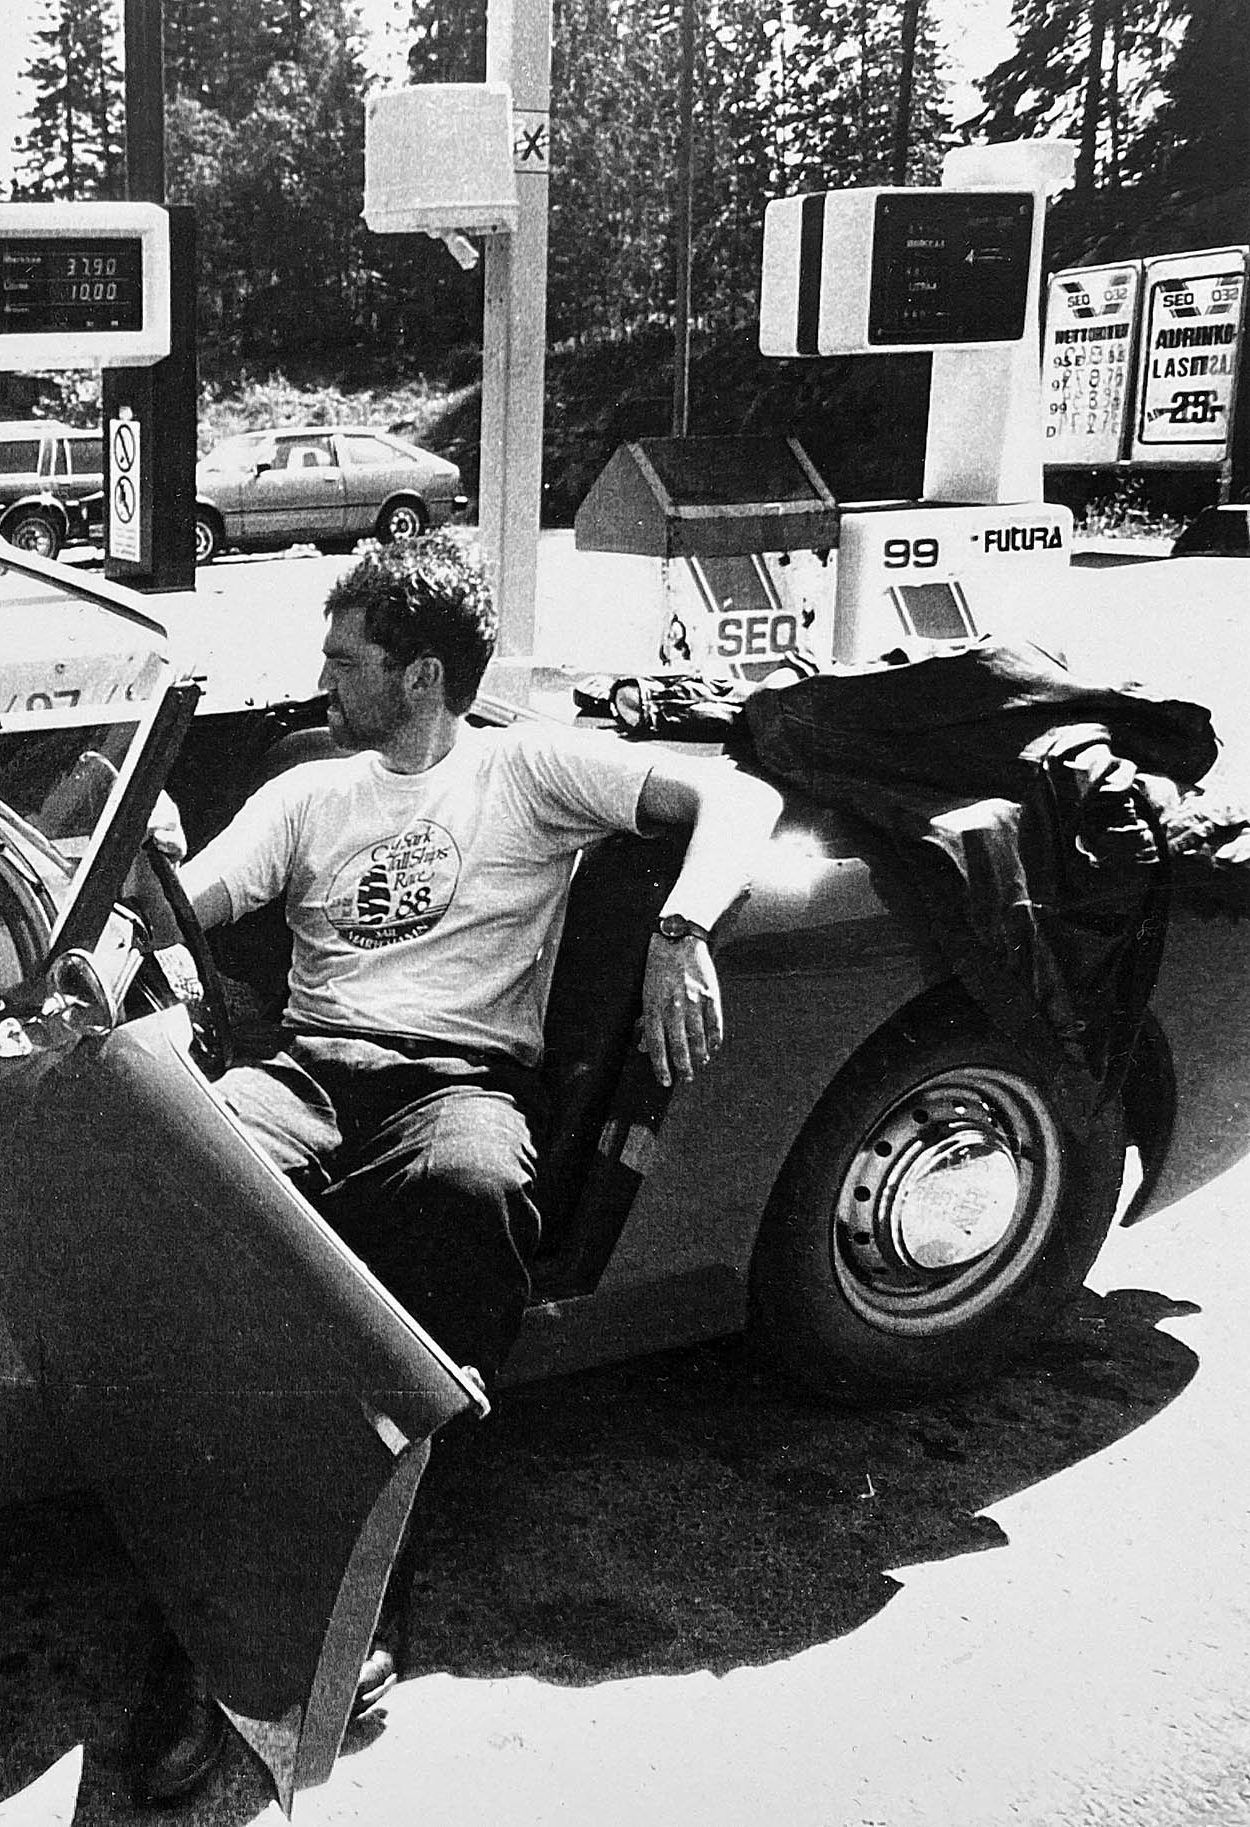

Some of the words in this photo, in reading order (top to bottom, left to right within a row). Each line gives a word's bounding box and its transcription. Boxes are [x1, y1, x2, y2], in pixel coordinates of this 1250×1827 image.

[1067, 294, 1090, 308] SEO
[1163, 293, 1194, 307] SEO
[984, 526, 1063, 553] FUTURA
[884, 539, 939, 568] 99
[717, 614, 797, 657] SEO
